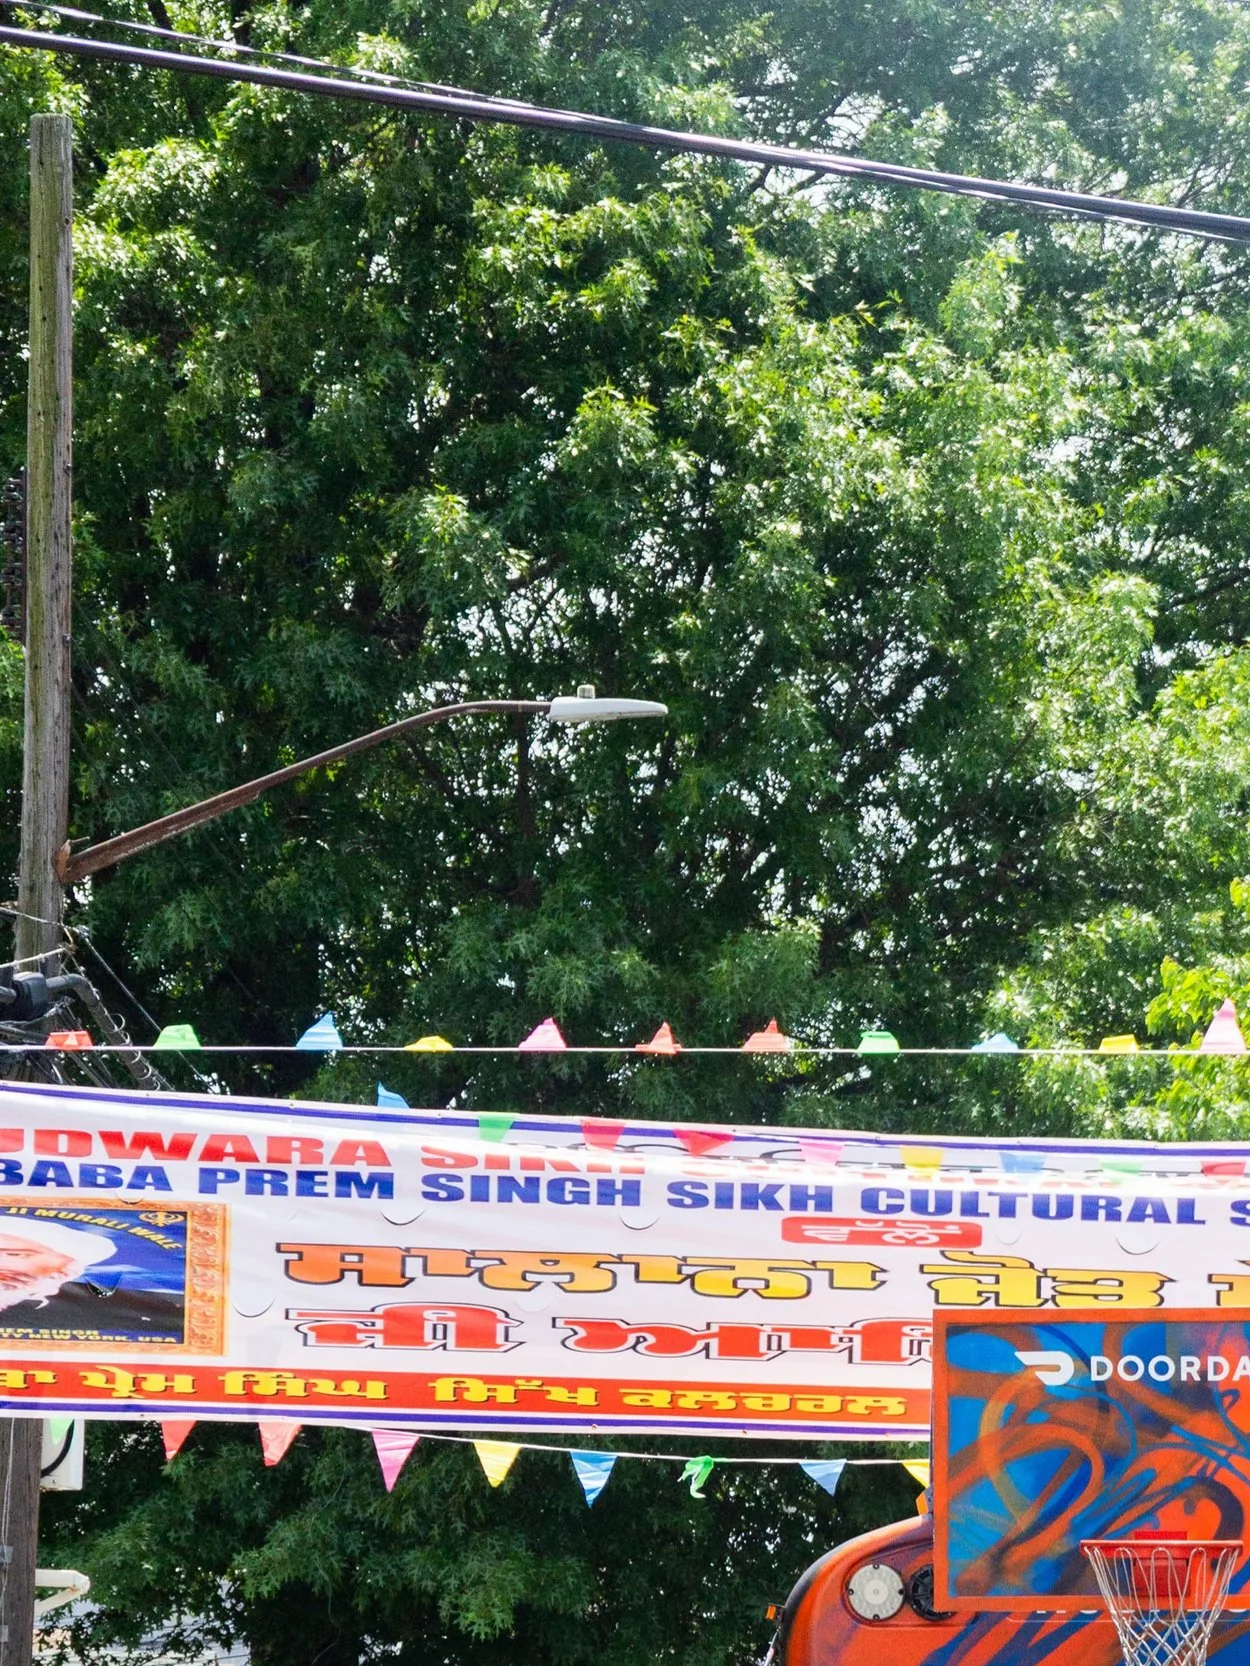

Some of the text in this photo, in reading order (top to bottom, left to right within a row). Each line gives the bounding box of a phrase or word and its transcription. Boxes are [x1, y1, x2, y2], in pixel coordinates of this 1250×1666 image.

[34, 1209, 129, 1229] MURALI
[198, 1167, 394, 1200] PREM
[421, 1173, 640, 1207] SINGH
[667, 1180, 833, 1213] SIKH
[861, 1186, 1206, 1225] CULTURAL
[285, 1301, 524, 1352] ਜੀ
